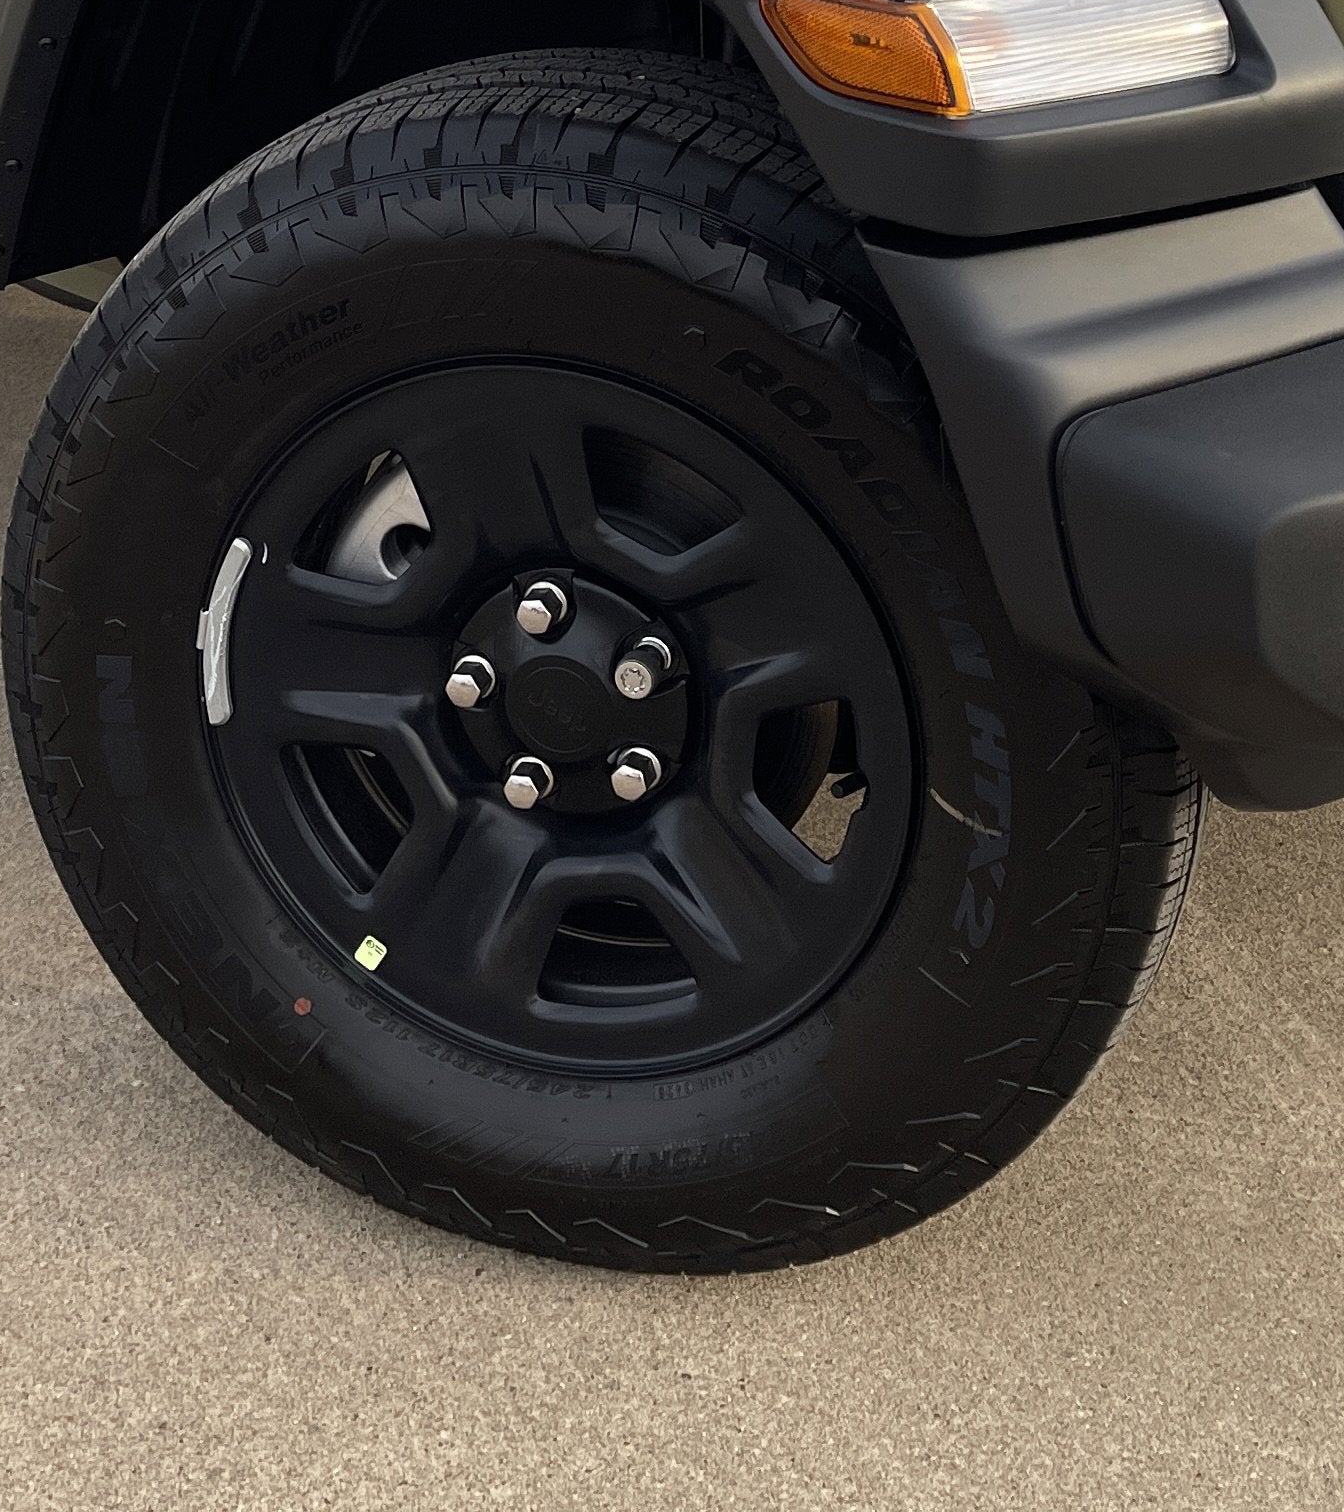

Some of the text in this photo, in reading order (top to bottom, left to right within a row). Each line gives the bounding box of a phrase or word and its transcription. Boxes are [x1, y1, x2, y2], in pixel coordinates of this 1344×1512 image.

[258, 322, 363, 386] Performance
[712, 347, 996, 681] ROADIAN
[951, 701, 1013, 949] HTX2
